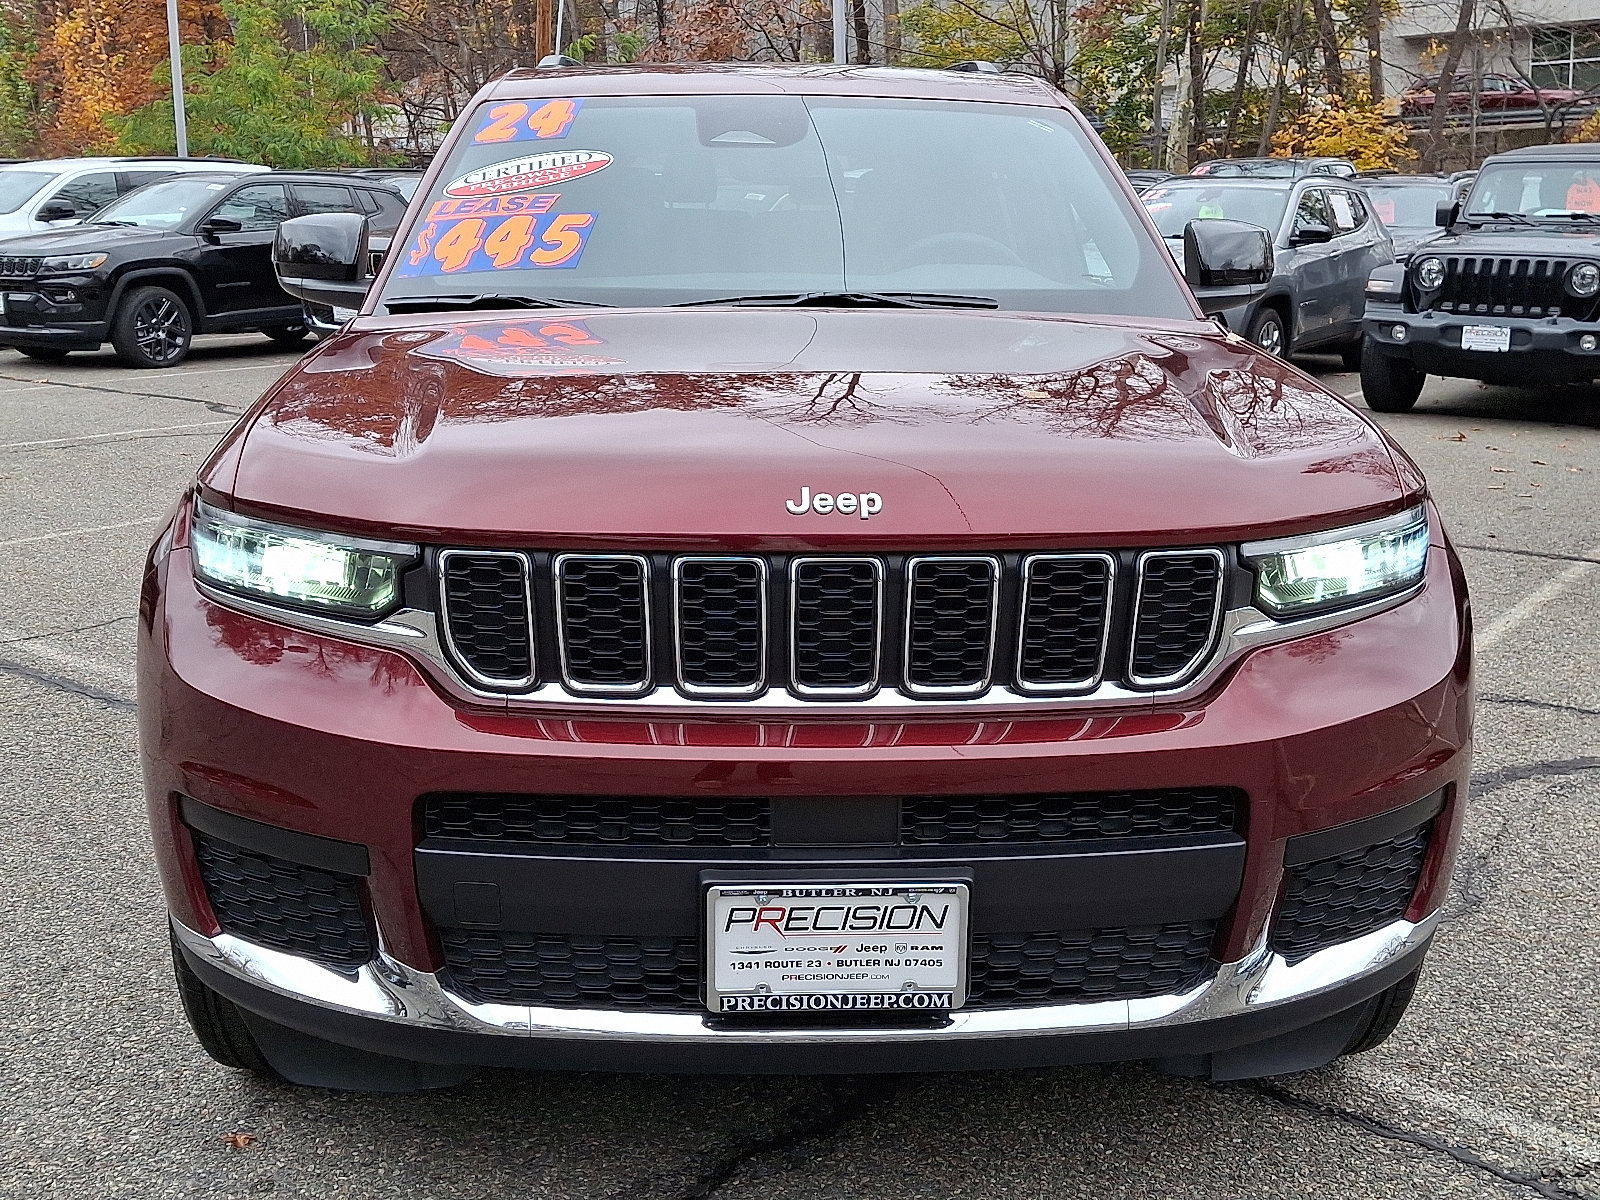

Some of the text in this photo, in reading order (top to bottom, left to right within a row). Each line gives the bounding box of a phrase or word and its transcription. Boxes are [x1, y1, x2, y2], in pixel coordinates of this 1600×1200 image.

[475, 99, 575, 143] 24
[464, 152, 593, 184] CERTIFIED
[487, 171, 572, 192] VEHICLE
[433, 195, 557, 216] LEASE
[409, 213, 594, 273] $445
[785, 486, 883, 520] Jeep
[871, 888, 893, 896] NJ
[724, 905, 949, 938] PRECISION
[856, 943, 888, 954] Jeep
[729, 959, 943, 970] 1341 ROUTE 23 BUTLER NJ 07405
[720, 994, 951, 1011] PRECISIONJEEP.COM
